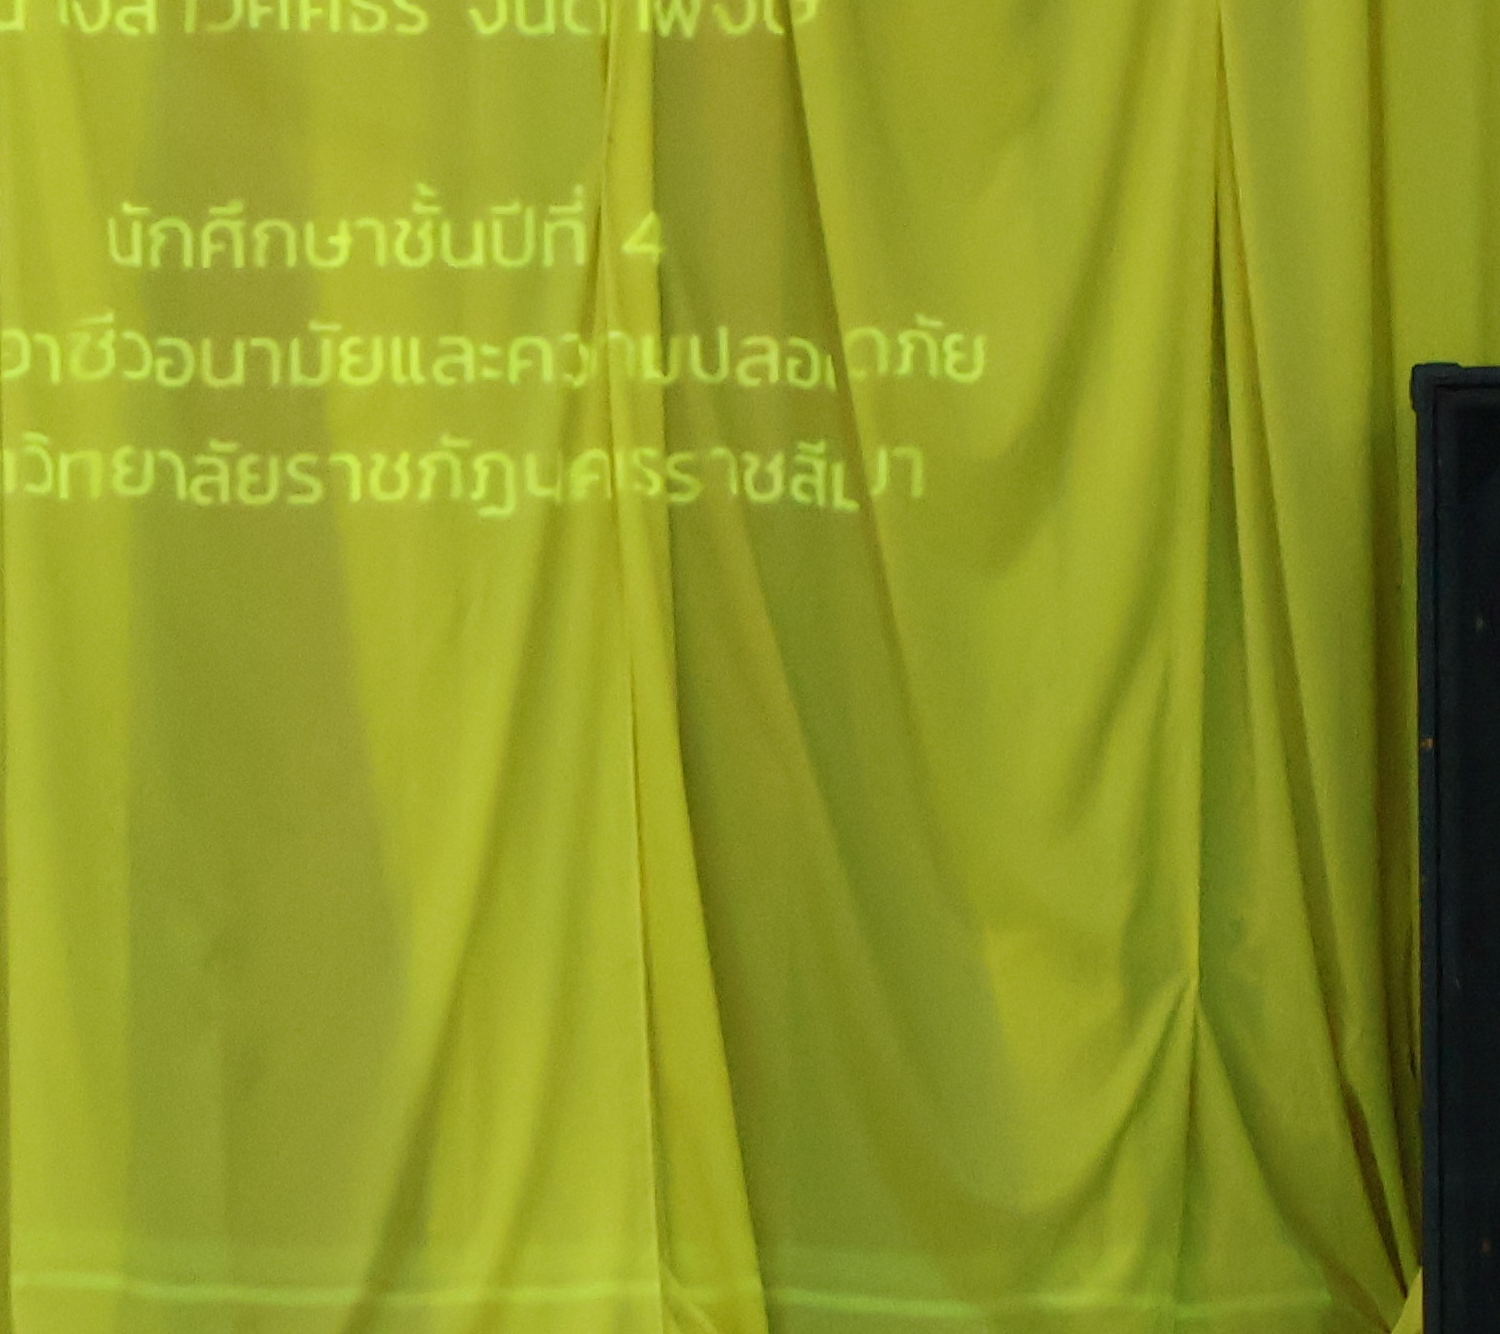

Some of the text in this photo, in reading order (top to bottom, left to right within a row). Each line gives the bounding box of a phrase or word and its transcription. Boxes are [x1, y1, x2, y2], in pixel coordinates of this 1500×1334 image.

[106, 182, 663, 271] นักศึกษาชั้นปีที่ 4
